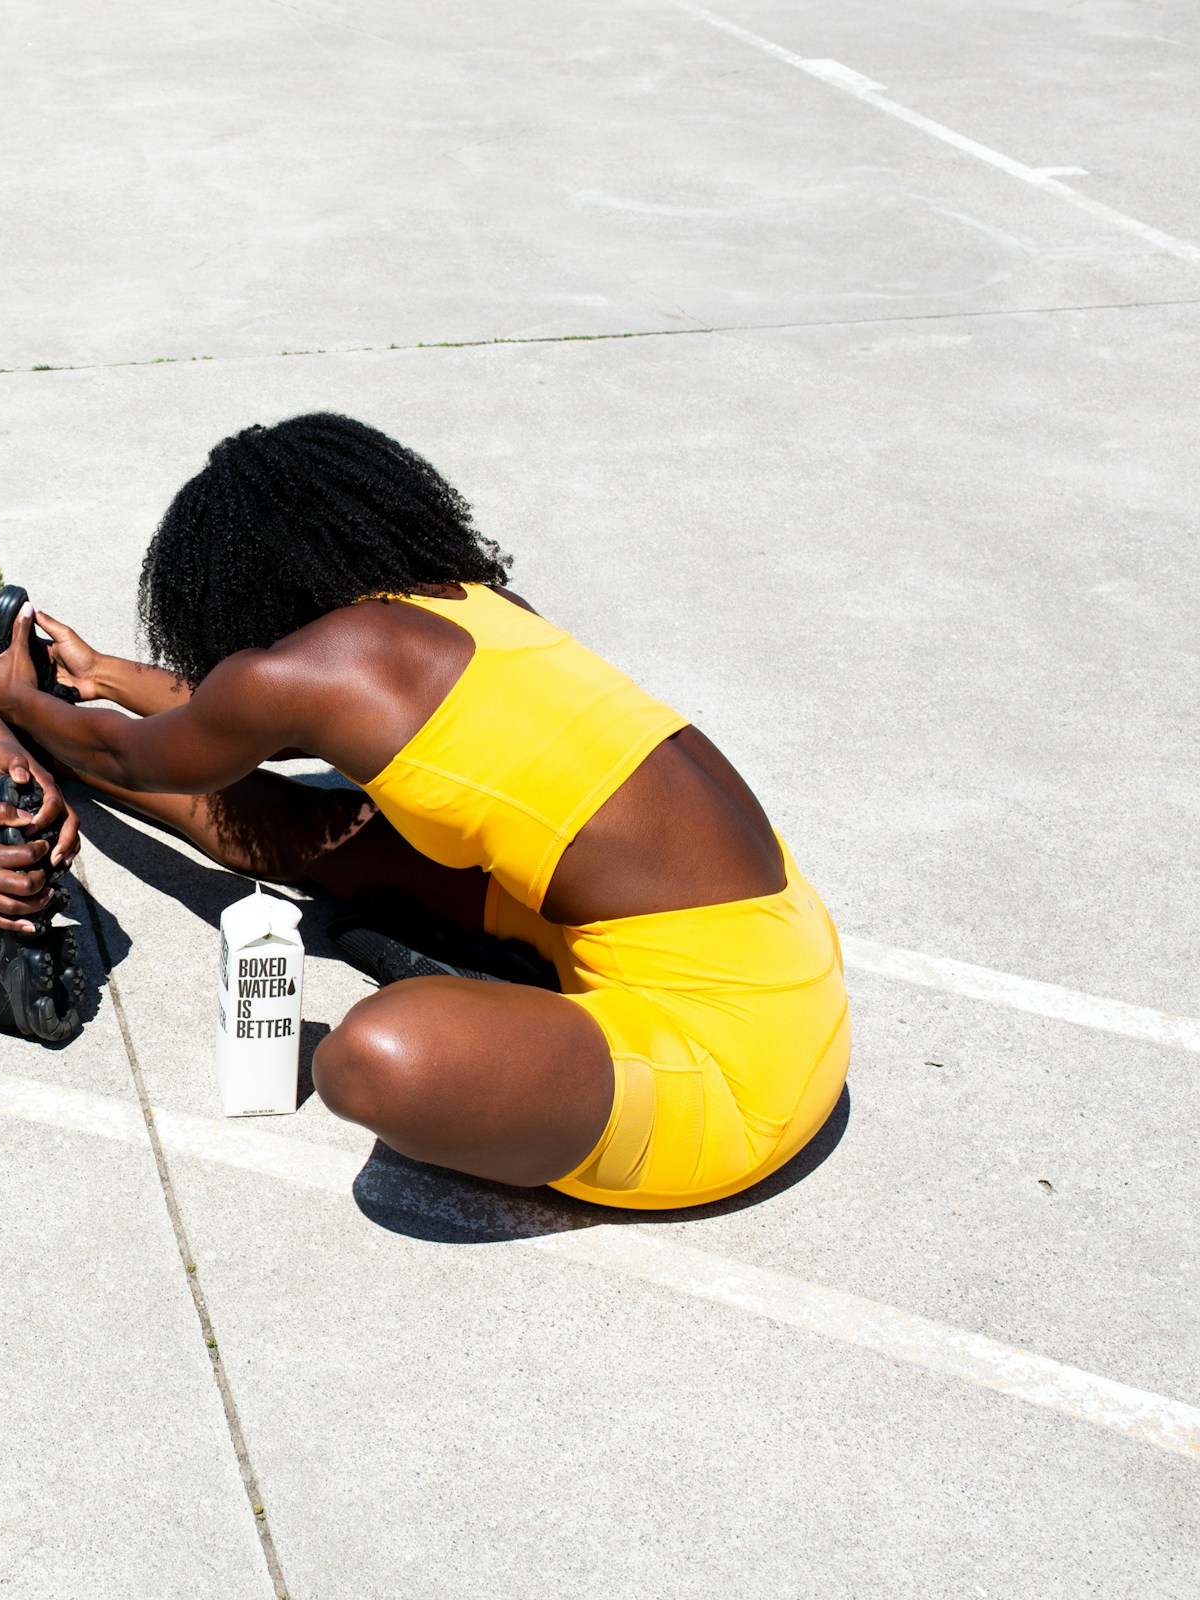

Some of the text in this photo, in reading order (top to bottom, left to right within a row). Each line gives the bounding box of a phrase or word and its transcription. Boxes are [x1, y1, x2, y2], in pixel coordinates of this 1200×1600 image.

[238, 957, 287, 978] BOXED
[237, 978, 287, 998] WATER
[237, 999, 252, 1019] IS
[236, 1017, 295, 1039] BETTER.
